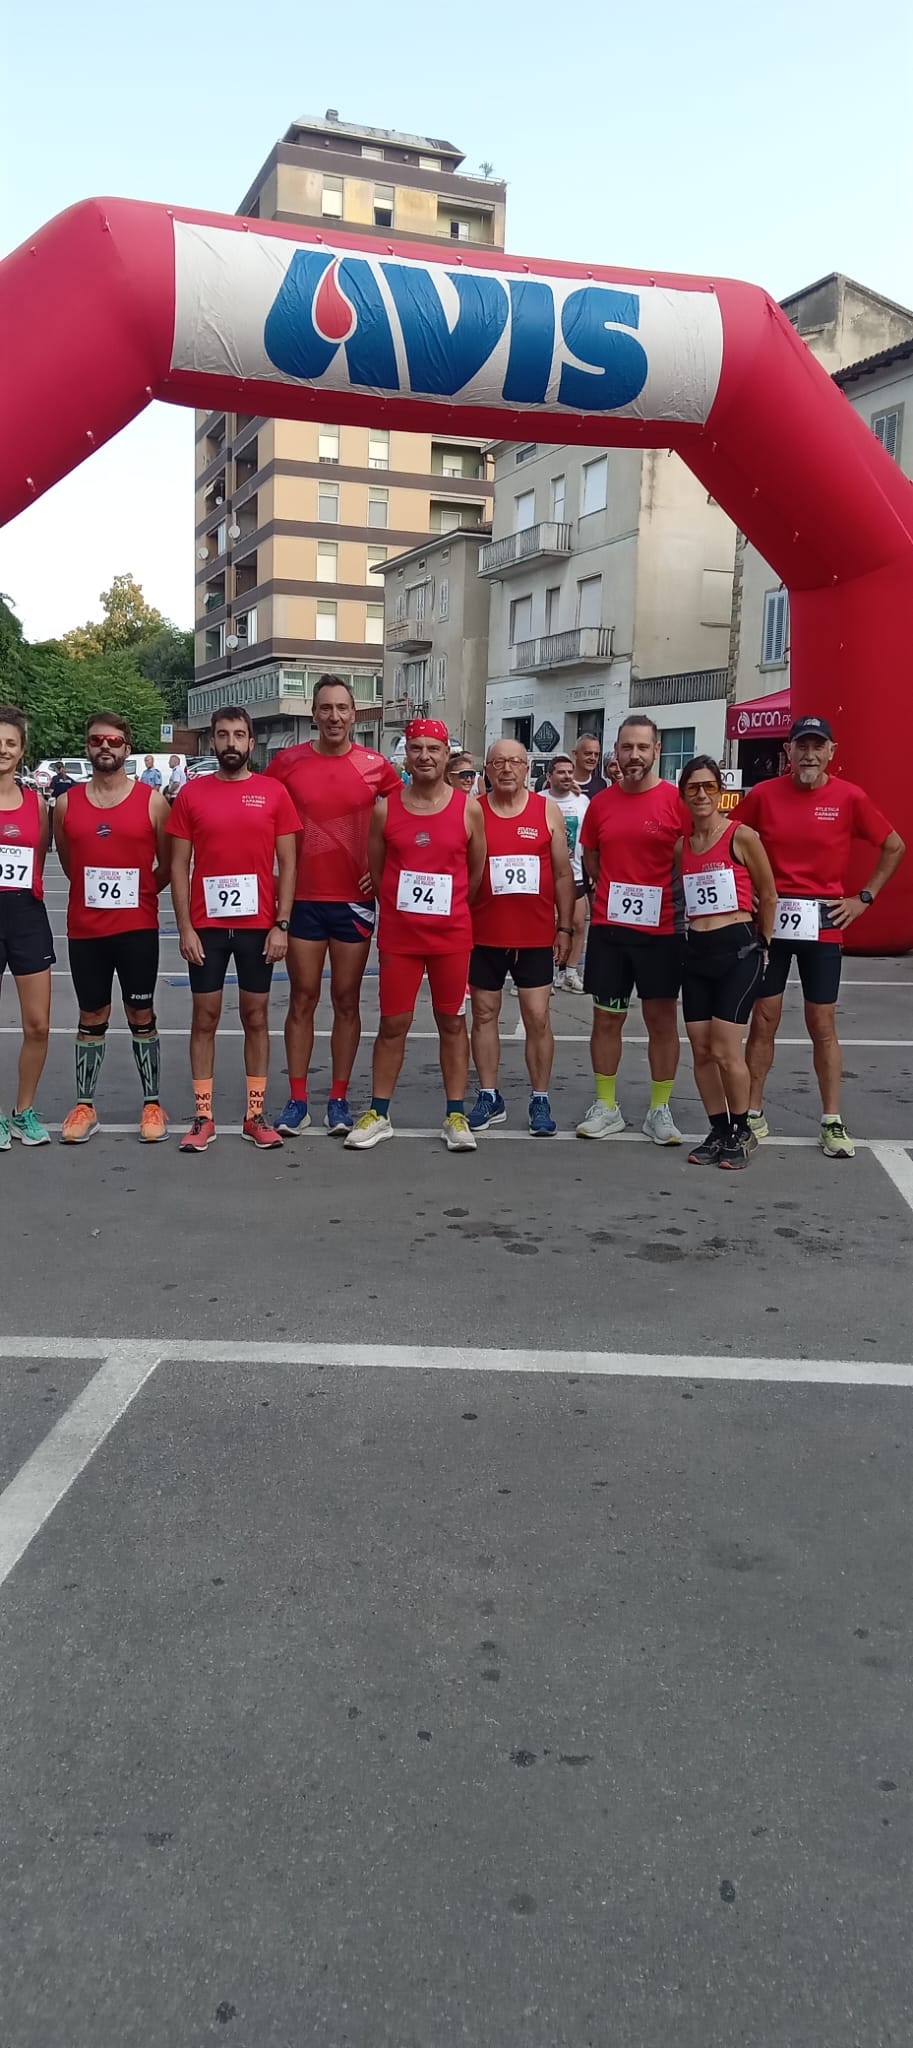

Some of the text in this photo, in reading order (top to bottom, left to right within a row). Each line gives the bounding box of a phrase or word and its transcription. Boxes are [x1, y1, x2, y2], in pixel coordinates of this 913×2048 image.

[264, 249, 649, 411] AVIS
[505, 868, 527, 885] 98
[98, 882, 121, 899] 96
[218, 889, 242, 908] 92
[412, 886, 435, 905] 94
[696, 886, 718, 905] 35
[621, 897, 644, 916] 93
[779, 912, 802, 931] 99
